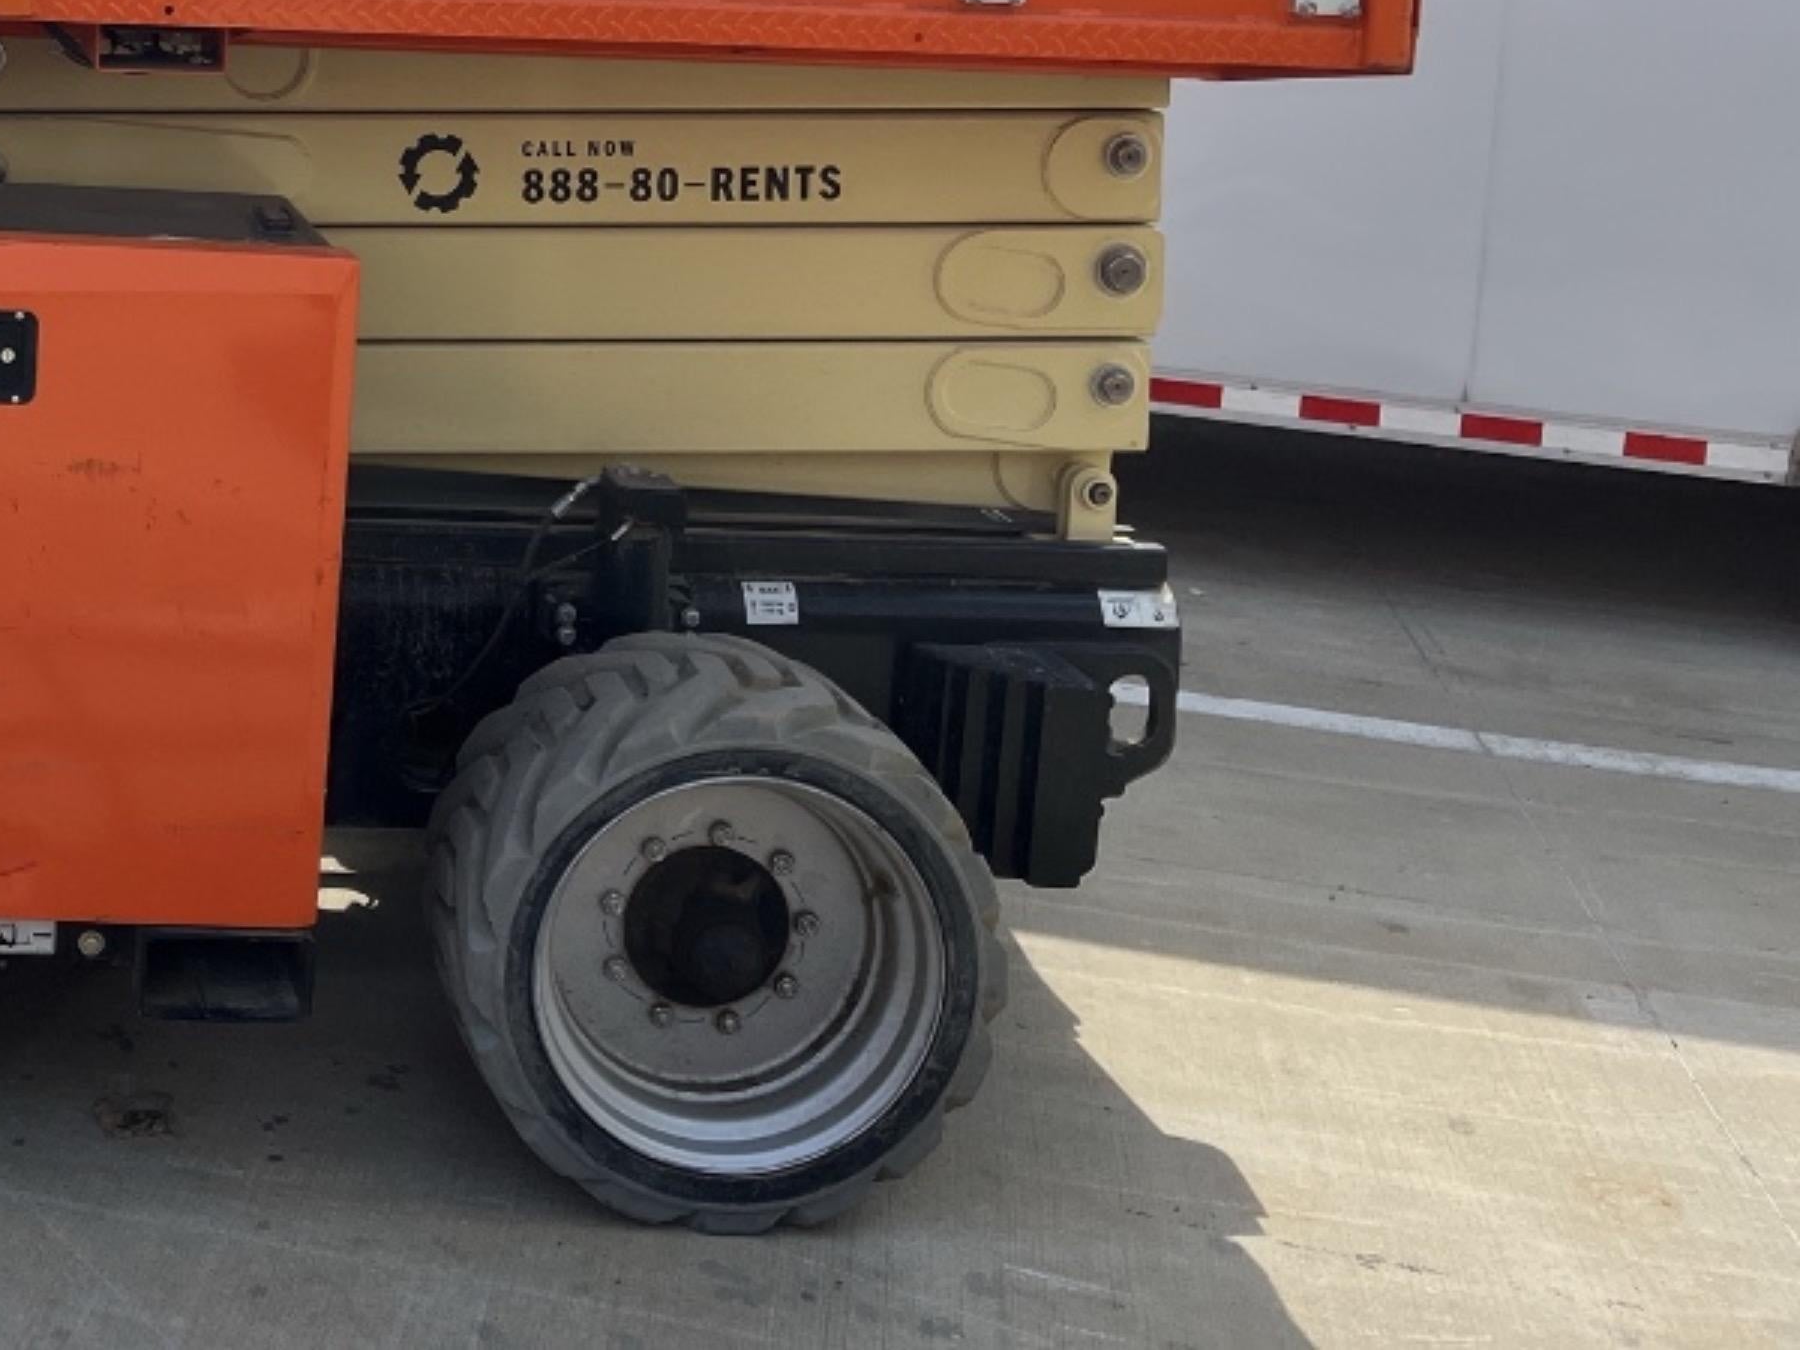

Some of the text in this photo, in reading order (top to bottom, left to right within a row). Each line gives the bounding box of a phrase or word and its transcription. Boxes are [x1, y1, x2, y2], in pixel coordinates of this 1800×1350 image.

[521, 140, 636, 157] CALL NOW
[521, 165, 842, 205] 888-80-RENTS
